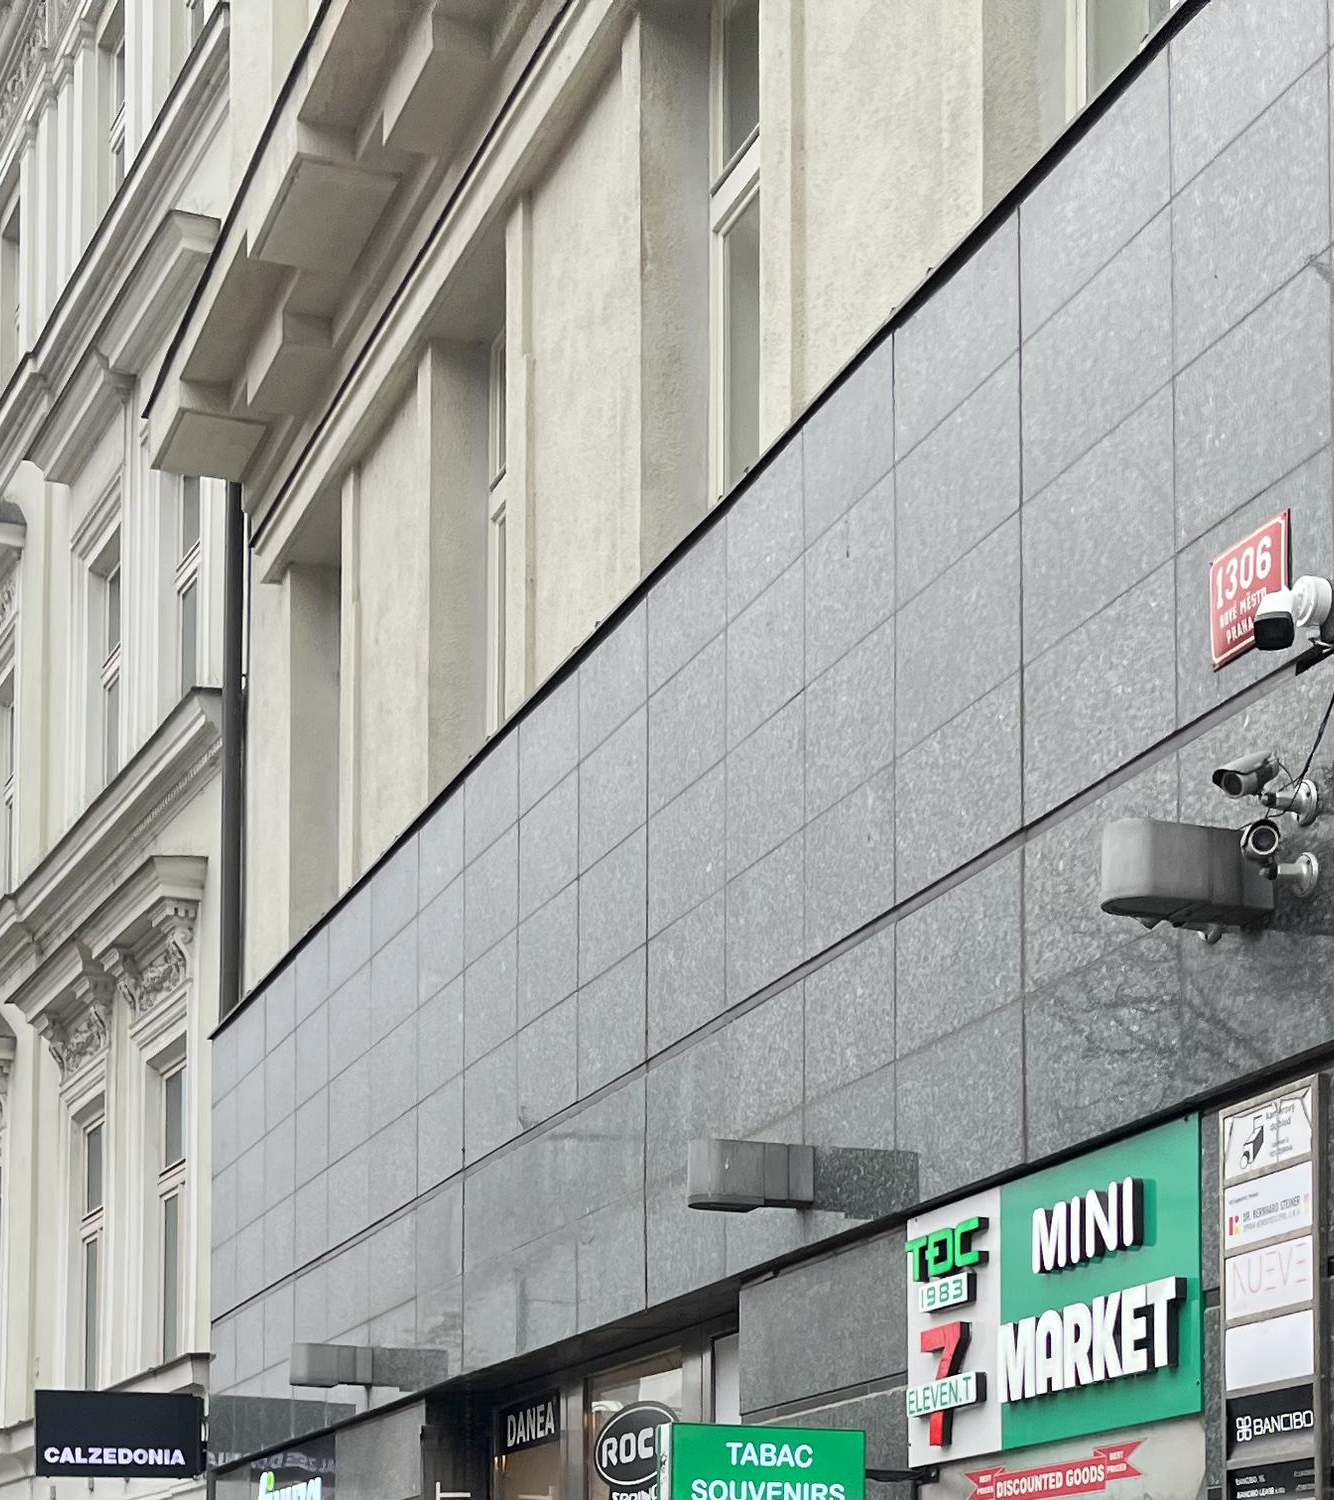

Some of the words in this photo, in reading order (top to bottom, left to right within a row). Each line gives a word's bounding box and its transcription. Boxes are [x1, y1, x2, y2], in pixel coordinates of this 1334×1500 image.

[1216, 536, 1272, 609] 1306
[1226, 616, 1255, 644] PRAHA
[1032, 1176, 1135, 1274] MINI
[920, 1279, 964, 1309] 1983
[999, 1276, 1176, 1404] MARKET
[506, 1401, 556, 1448] DANEA
[1253, 1410, 1314, 1436] BANCIBO
[44, 1447, 186, 1466] CALZEDONIA
[602, 1427, 658, 1468] ROC
[725, 1442, 814, 1468] TABAC
[996, 1473, 1063, 1498] DISCOUNTED
[1065, 1464, 1105, 1487] GOODS
